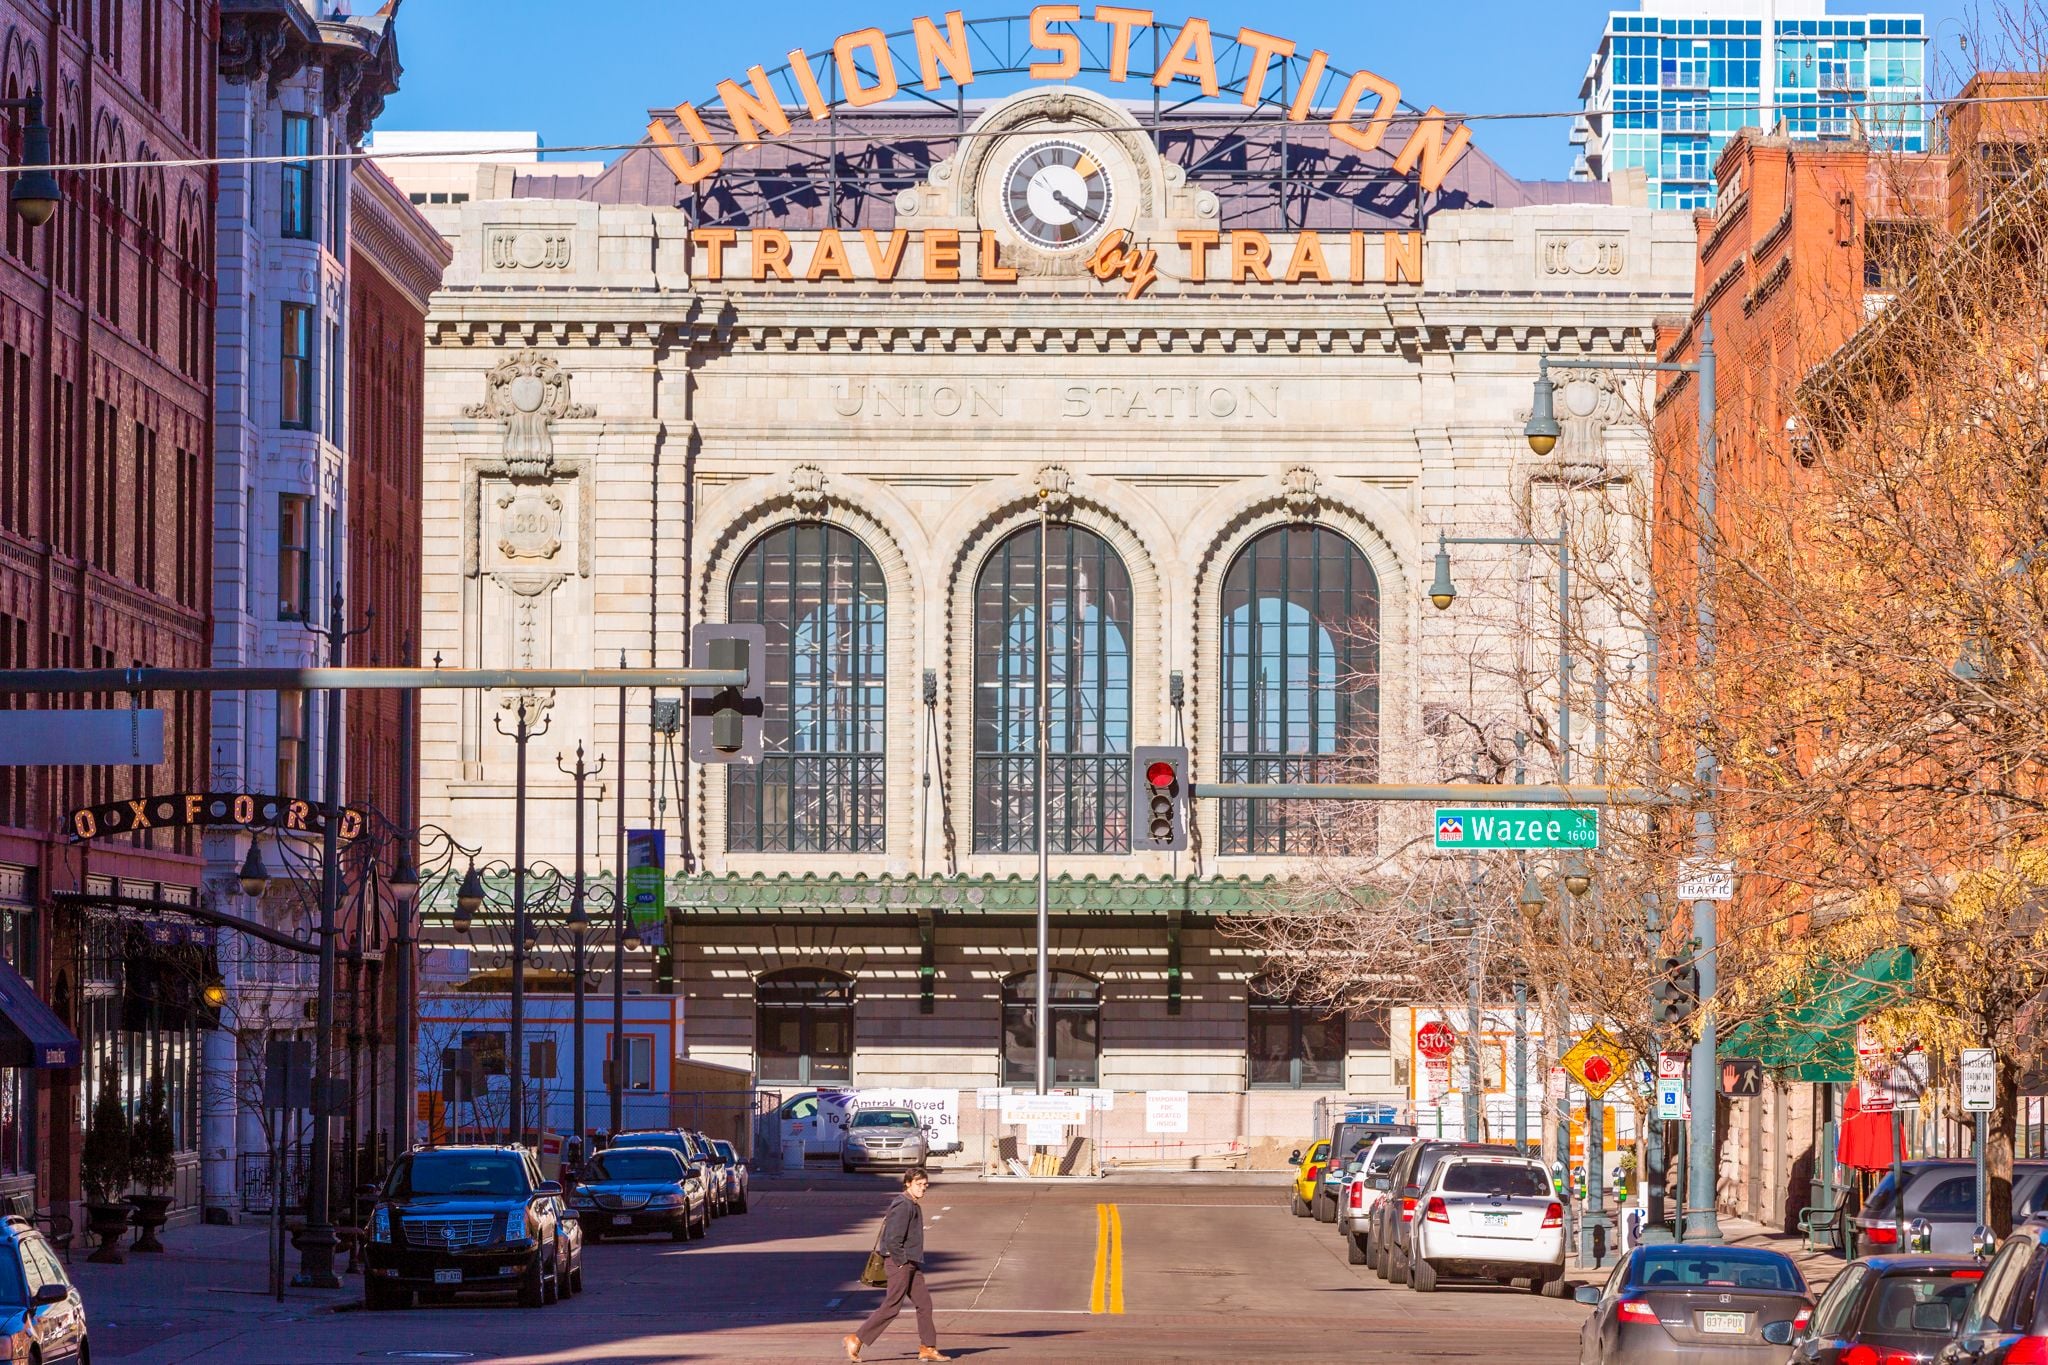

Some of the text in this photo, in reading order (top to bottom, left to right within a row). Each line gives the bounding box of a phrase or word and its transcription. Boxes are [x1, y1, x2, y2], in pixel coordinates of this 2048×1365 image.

[647, 5, 1473, 193] UNION STATION
[693, 228, 1424, 300] TRAVEL by TRAIN
[831, 385, 1280, 418] UNION STATION
[74, 795, 362, 840] OXFORD
[1575, 818, 1587, 828] St
[1471, 816, 1561, 841] Wazee
[1439, 832, 1463, 841] DENVER
[1567, 830, 1595, 841] 1600
[1681, 886, 1730, 895] TRAFFIC
[1420, 1034, 1452, 1048] STOP
[1965, 1060, 1992, 1068] PASSENGER
[1964, 1072, 1992, 1081] LOADING ONLY
[1966, 1085, 1991, 1094] 5PM-2AM
[851, 1099, 945, 1110] Amtrak Moved
[827, 1113, 840, 1124] To
[940, 1114, 955, 1125] St.
[1010, 1111, 1075, 1121] ENTRANCE
